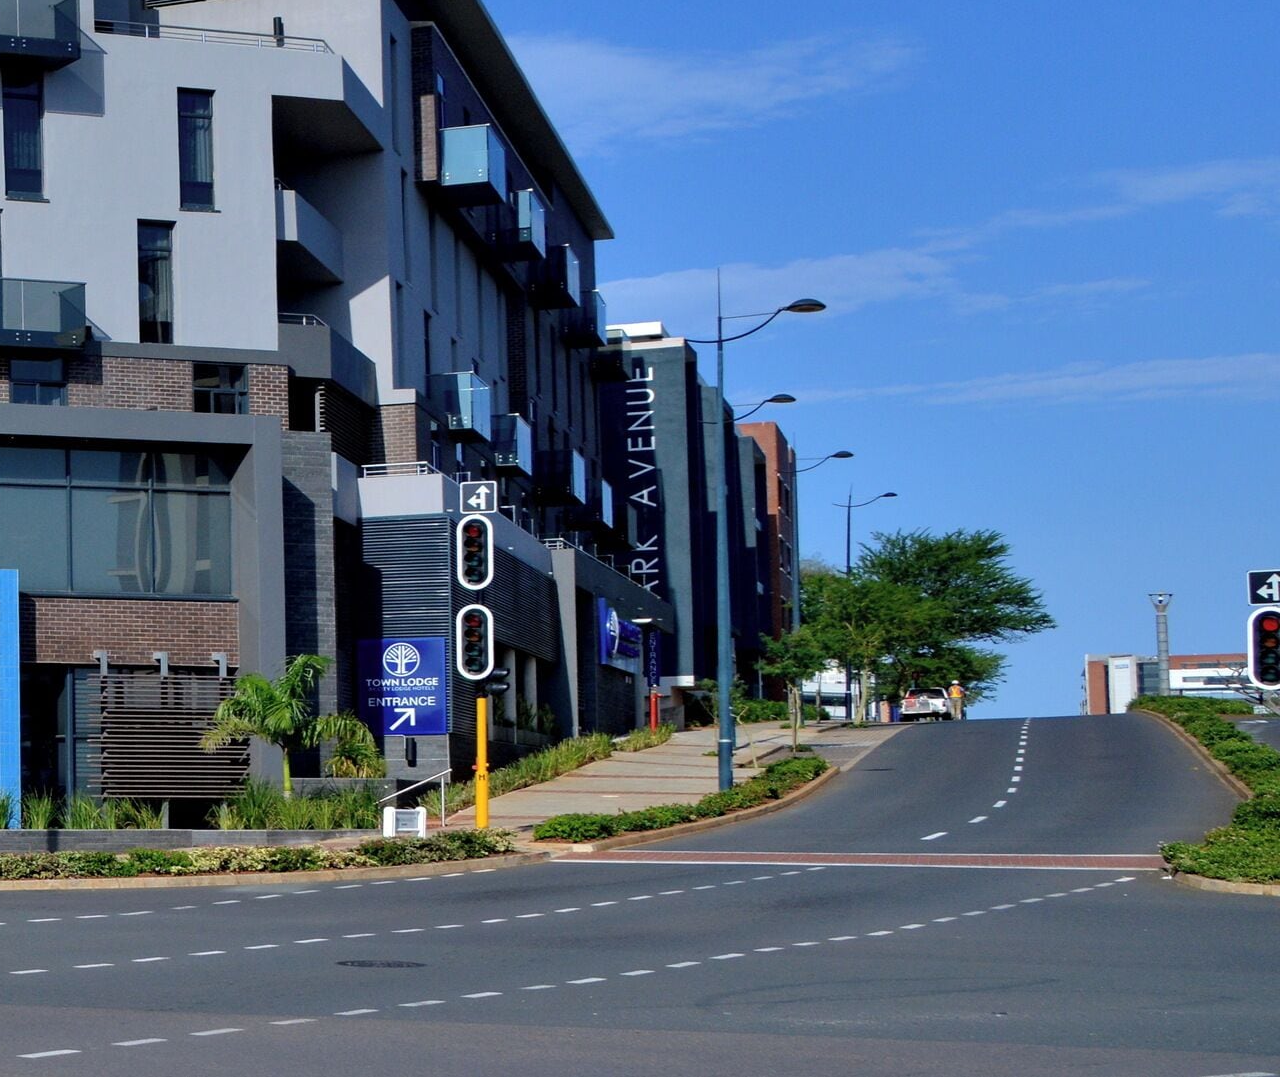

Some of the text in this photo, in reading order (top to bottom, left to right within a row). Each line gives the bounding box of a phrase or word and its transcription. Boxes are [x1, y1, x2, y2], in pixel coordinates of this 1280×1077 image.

[366, 677, 439, 687] TOWN LODGE
[367, 696, 436, 707] ENTRANCE
